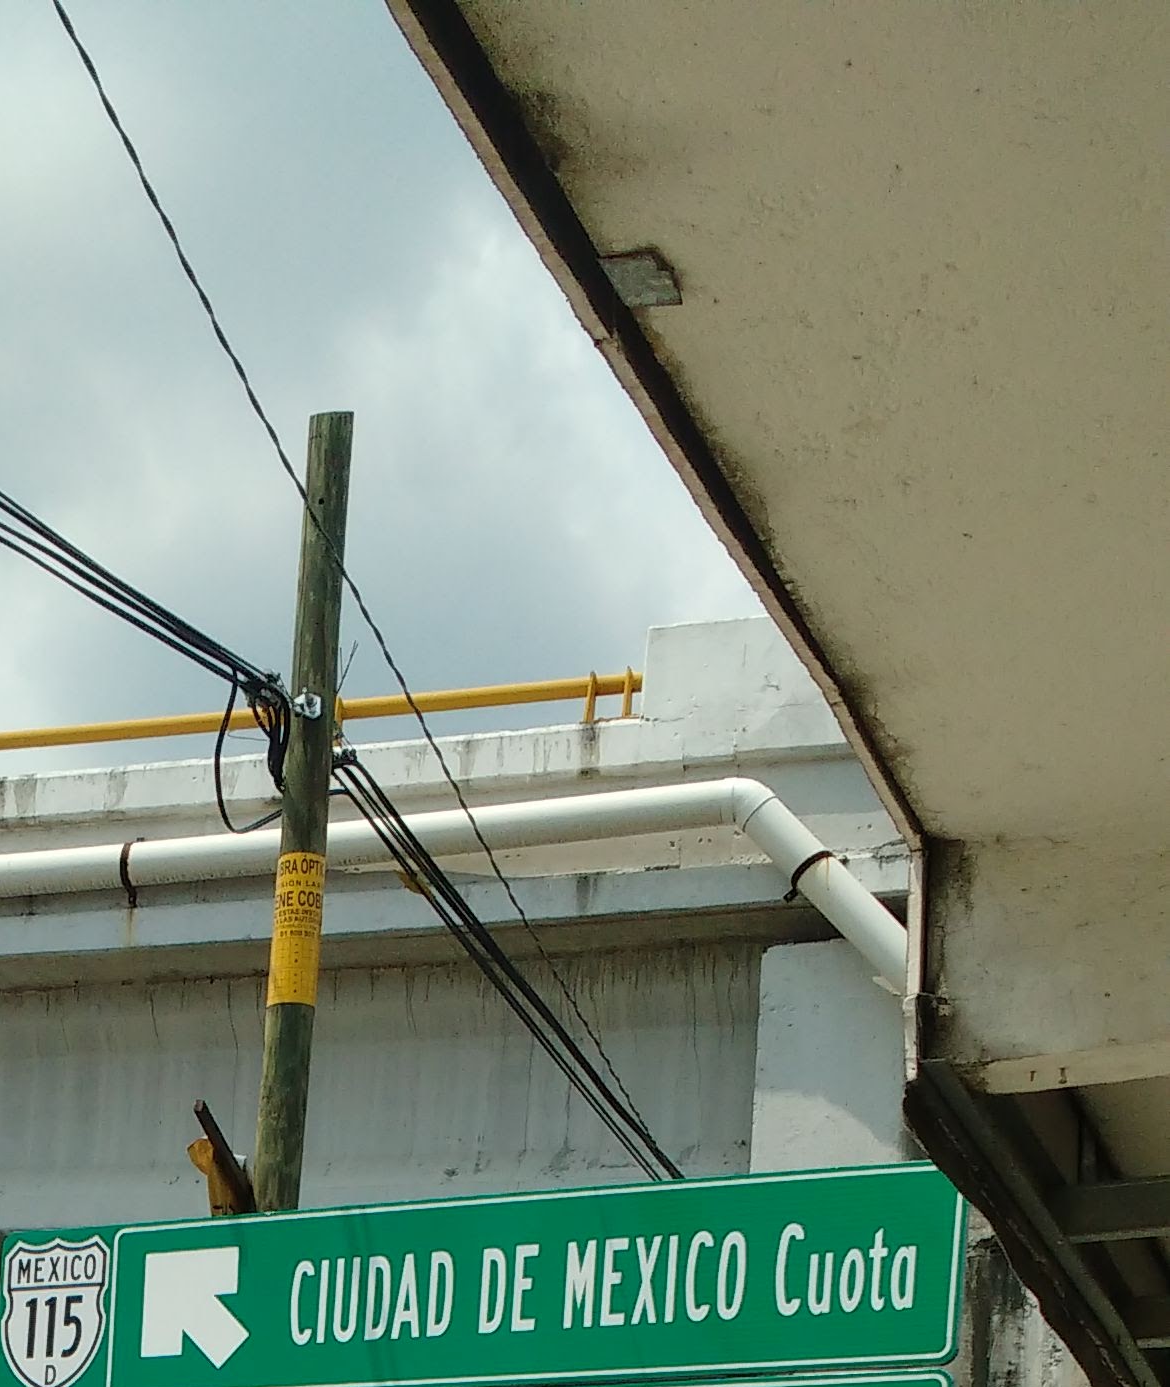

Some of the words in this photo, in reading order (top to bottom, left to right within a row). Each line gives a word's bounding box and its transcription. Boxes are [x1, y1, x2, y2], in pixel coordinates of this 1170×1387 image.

[17, 1253, 97, 1285] MEXICO
[290, 1249, 455, 1346] CIUDAD
[478, 1243, 540, 1335] DE
[562, 1229, 748, 1330] MEXICO
[774, 1222, 918, 1318] Cuota
[25, 1294, 84, 1360] 115
[44, 1364, 57, 1387] D
